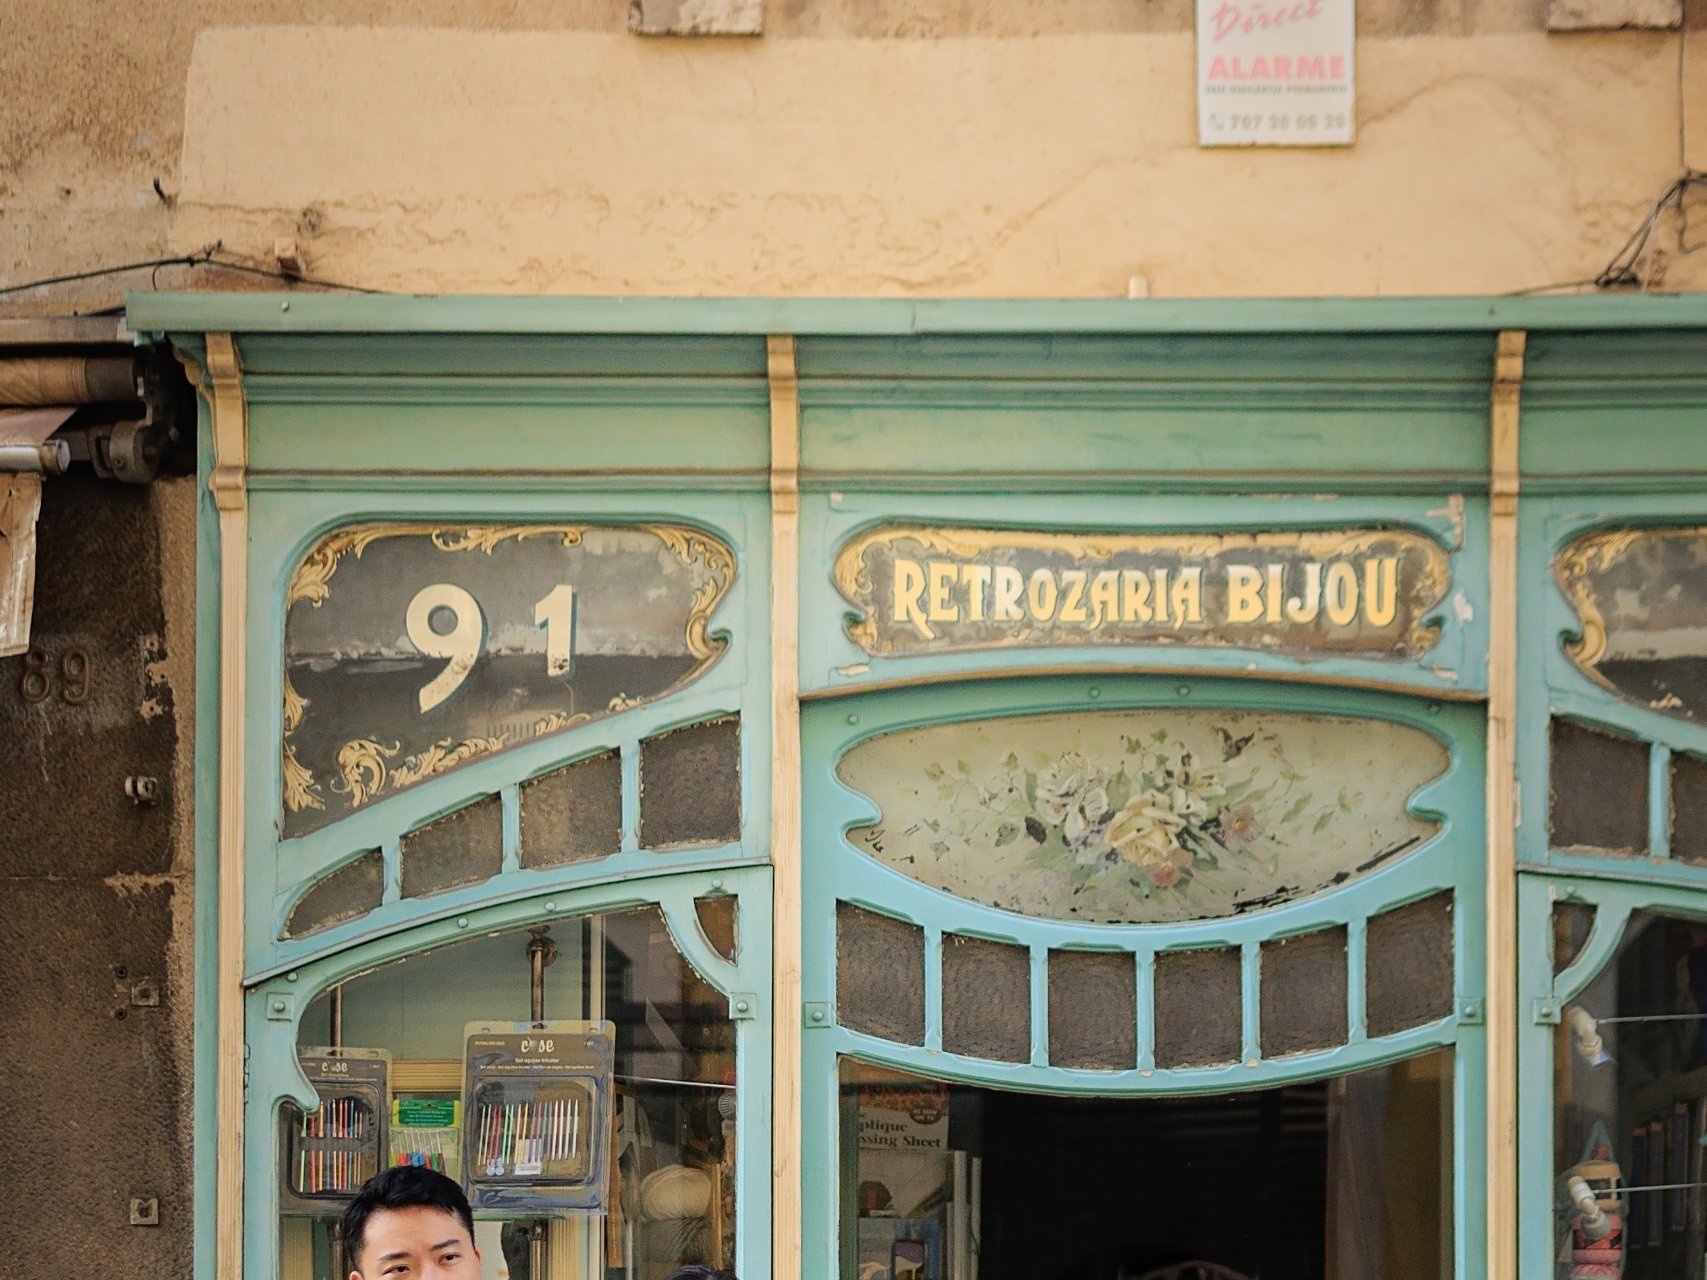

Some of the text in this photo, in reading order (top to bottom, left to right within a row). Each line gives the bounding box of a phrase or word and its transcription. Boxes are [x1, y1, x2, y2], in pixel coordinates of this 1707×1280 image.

[1208, 55, 1346, 80] ALARME
[892, 556, 1402, 640] RETROZARIA BIJOU
[406, 583, 577, 714] 91
[22, 649, 92, 702] 89
[903, 1136, 941, 1148] Sheet
